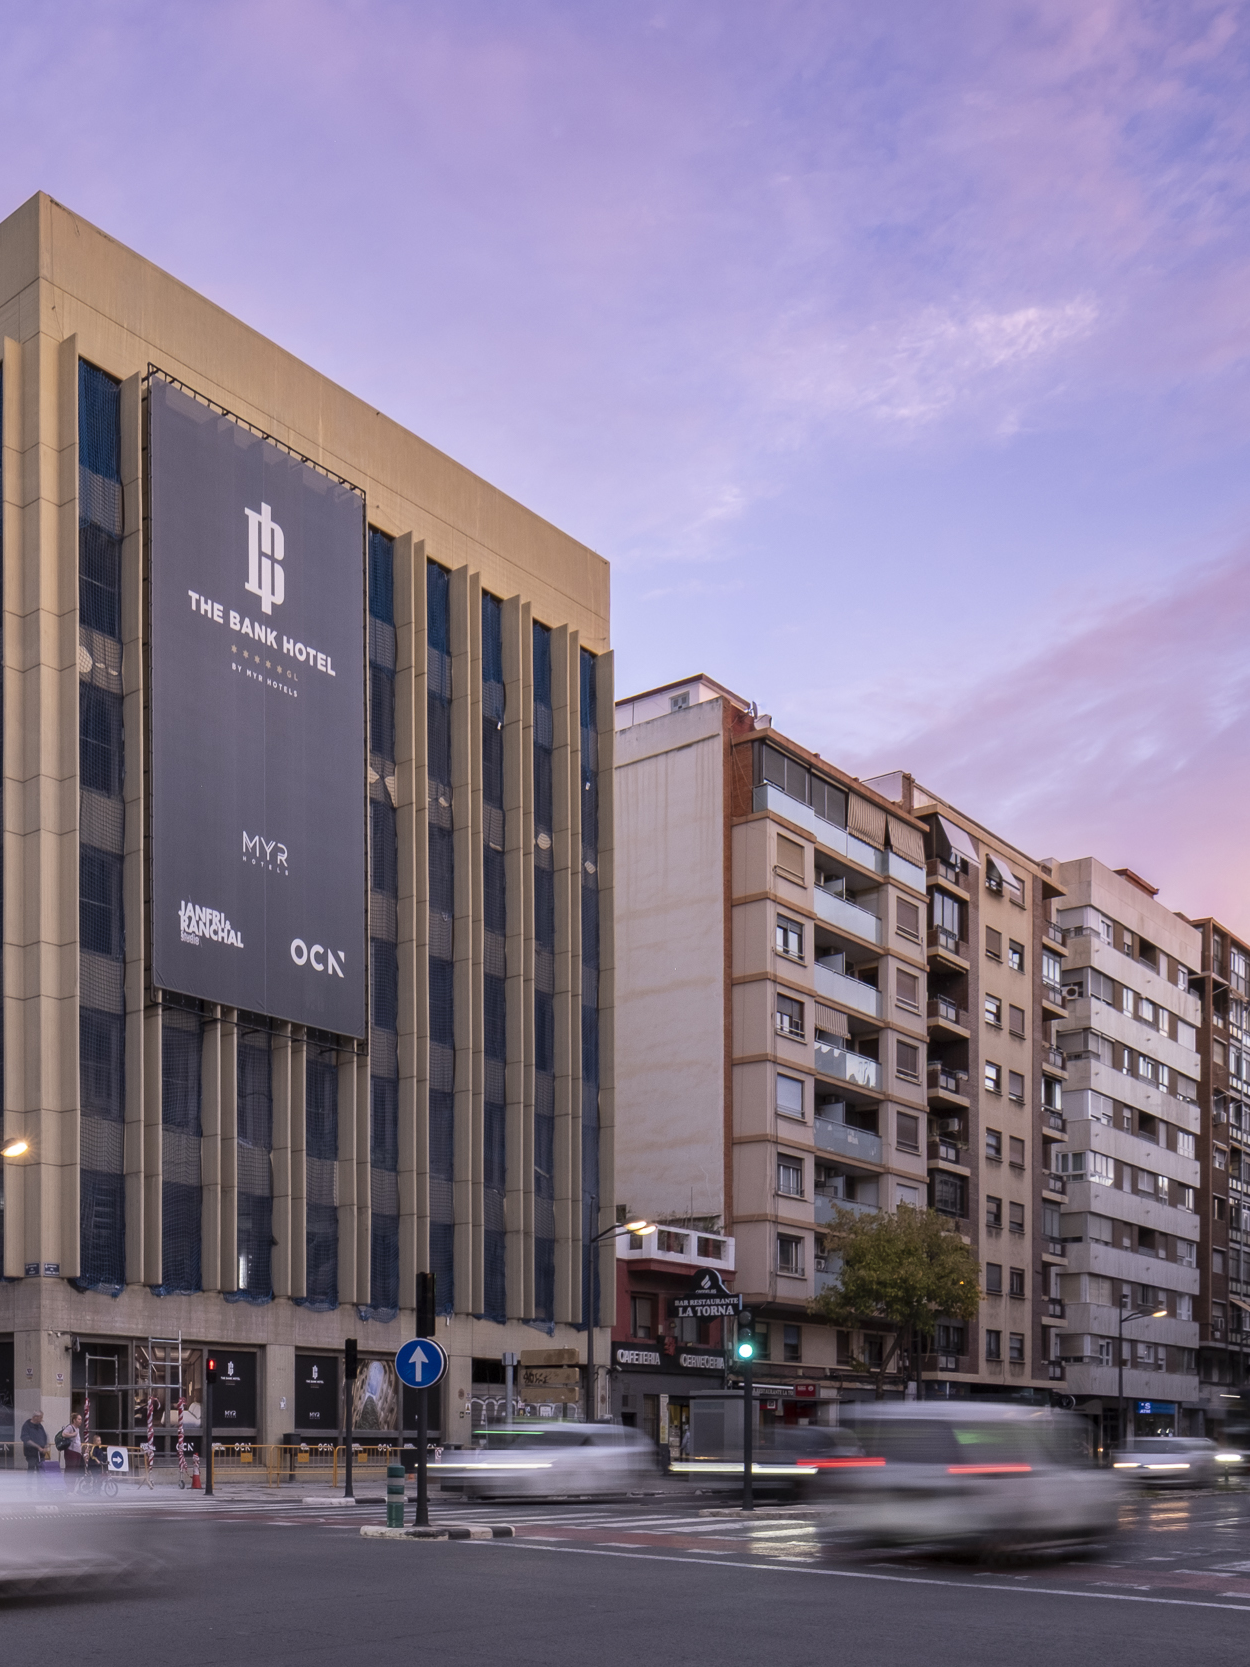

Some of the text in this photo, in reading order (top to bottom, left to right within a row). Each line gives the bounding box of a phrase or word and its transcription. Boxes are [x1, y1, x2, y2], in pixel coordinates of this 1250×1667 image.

[187, 589, 336, 677] THE BANK HOTEL
[231, 662, 298, 698] BY MYR HOTELS
[242, 830, 288, 867] MYR
[242, 856, 289, 876] HOTELS
[180, 915, 244, 949] RANCHAL
[678, 1305, 734, 1317] LA TORNA
[690, 1298, 738, 1306] RESTAURANTE
[616, 1349, 725, 1370] CAFETERIA CERVECERIA
